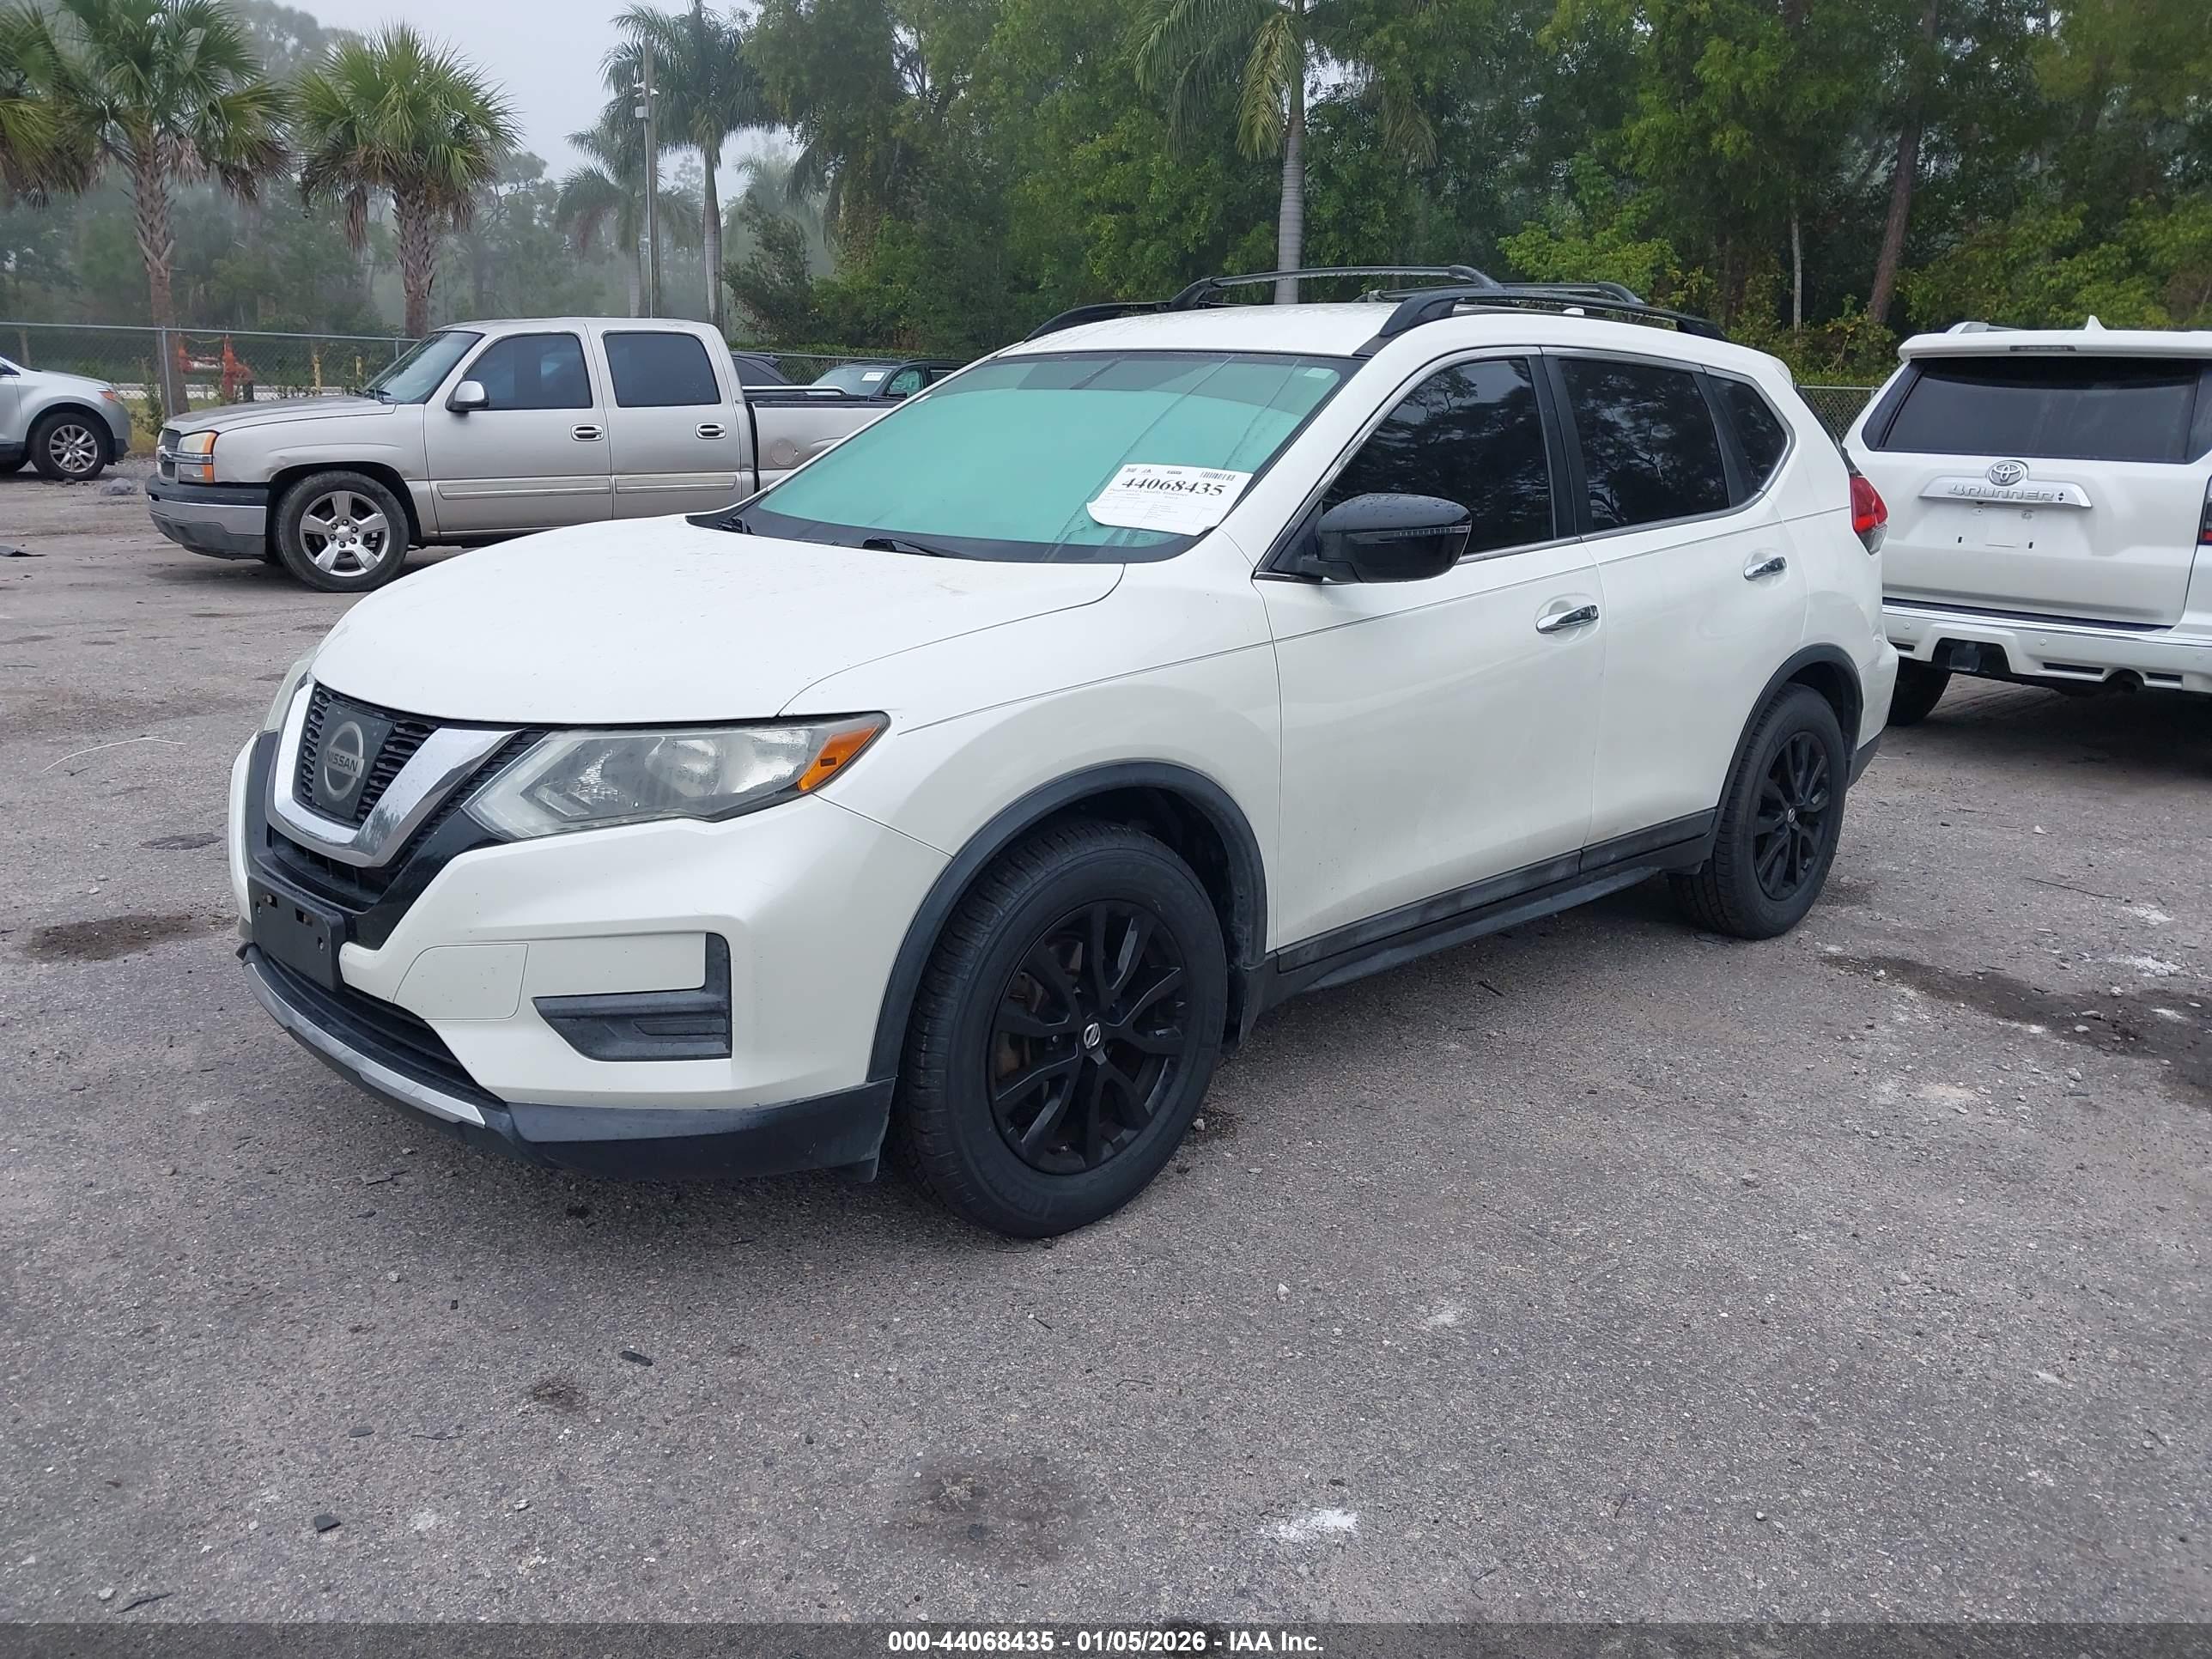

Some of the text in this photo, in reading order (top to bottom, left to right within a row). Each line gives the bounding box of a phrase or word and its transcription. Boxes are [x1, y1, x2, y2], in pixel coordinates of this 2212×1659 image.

[1121, 477, 1226, 496] 44068435
[1948, 484, 2055, 501] 4RUNNER
[326, 750, 359, 772] NISSAN
